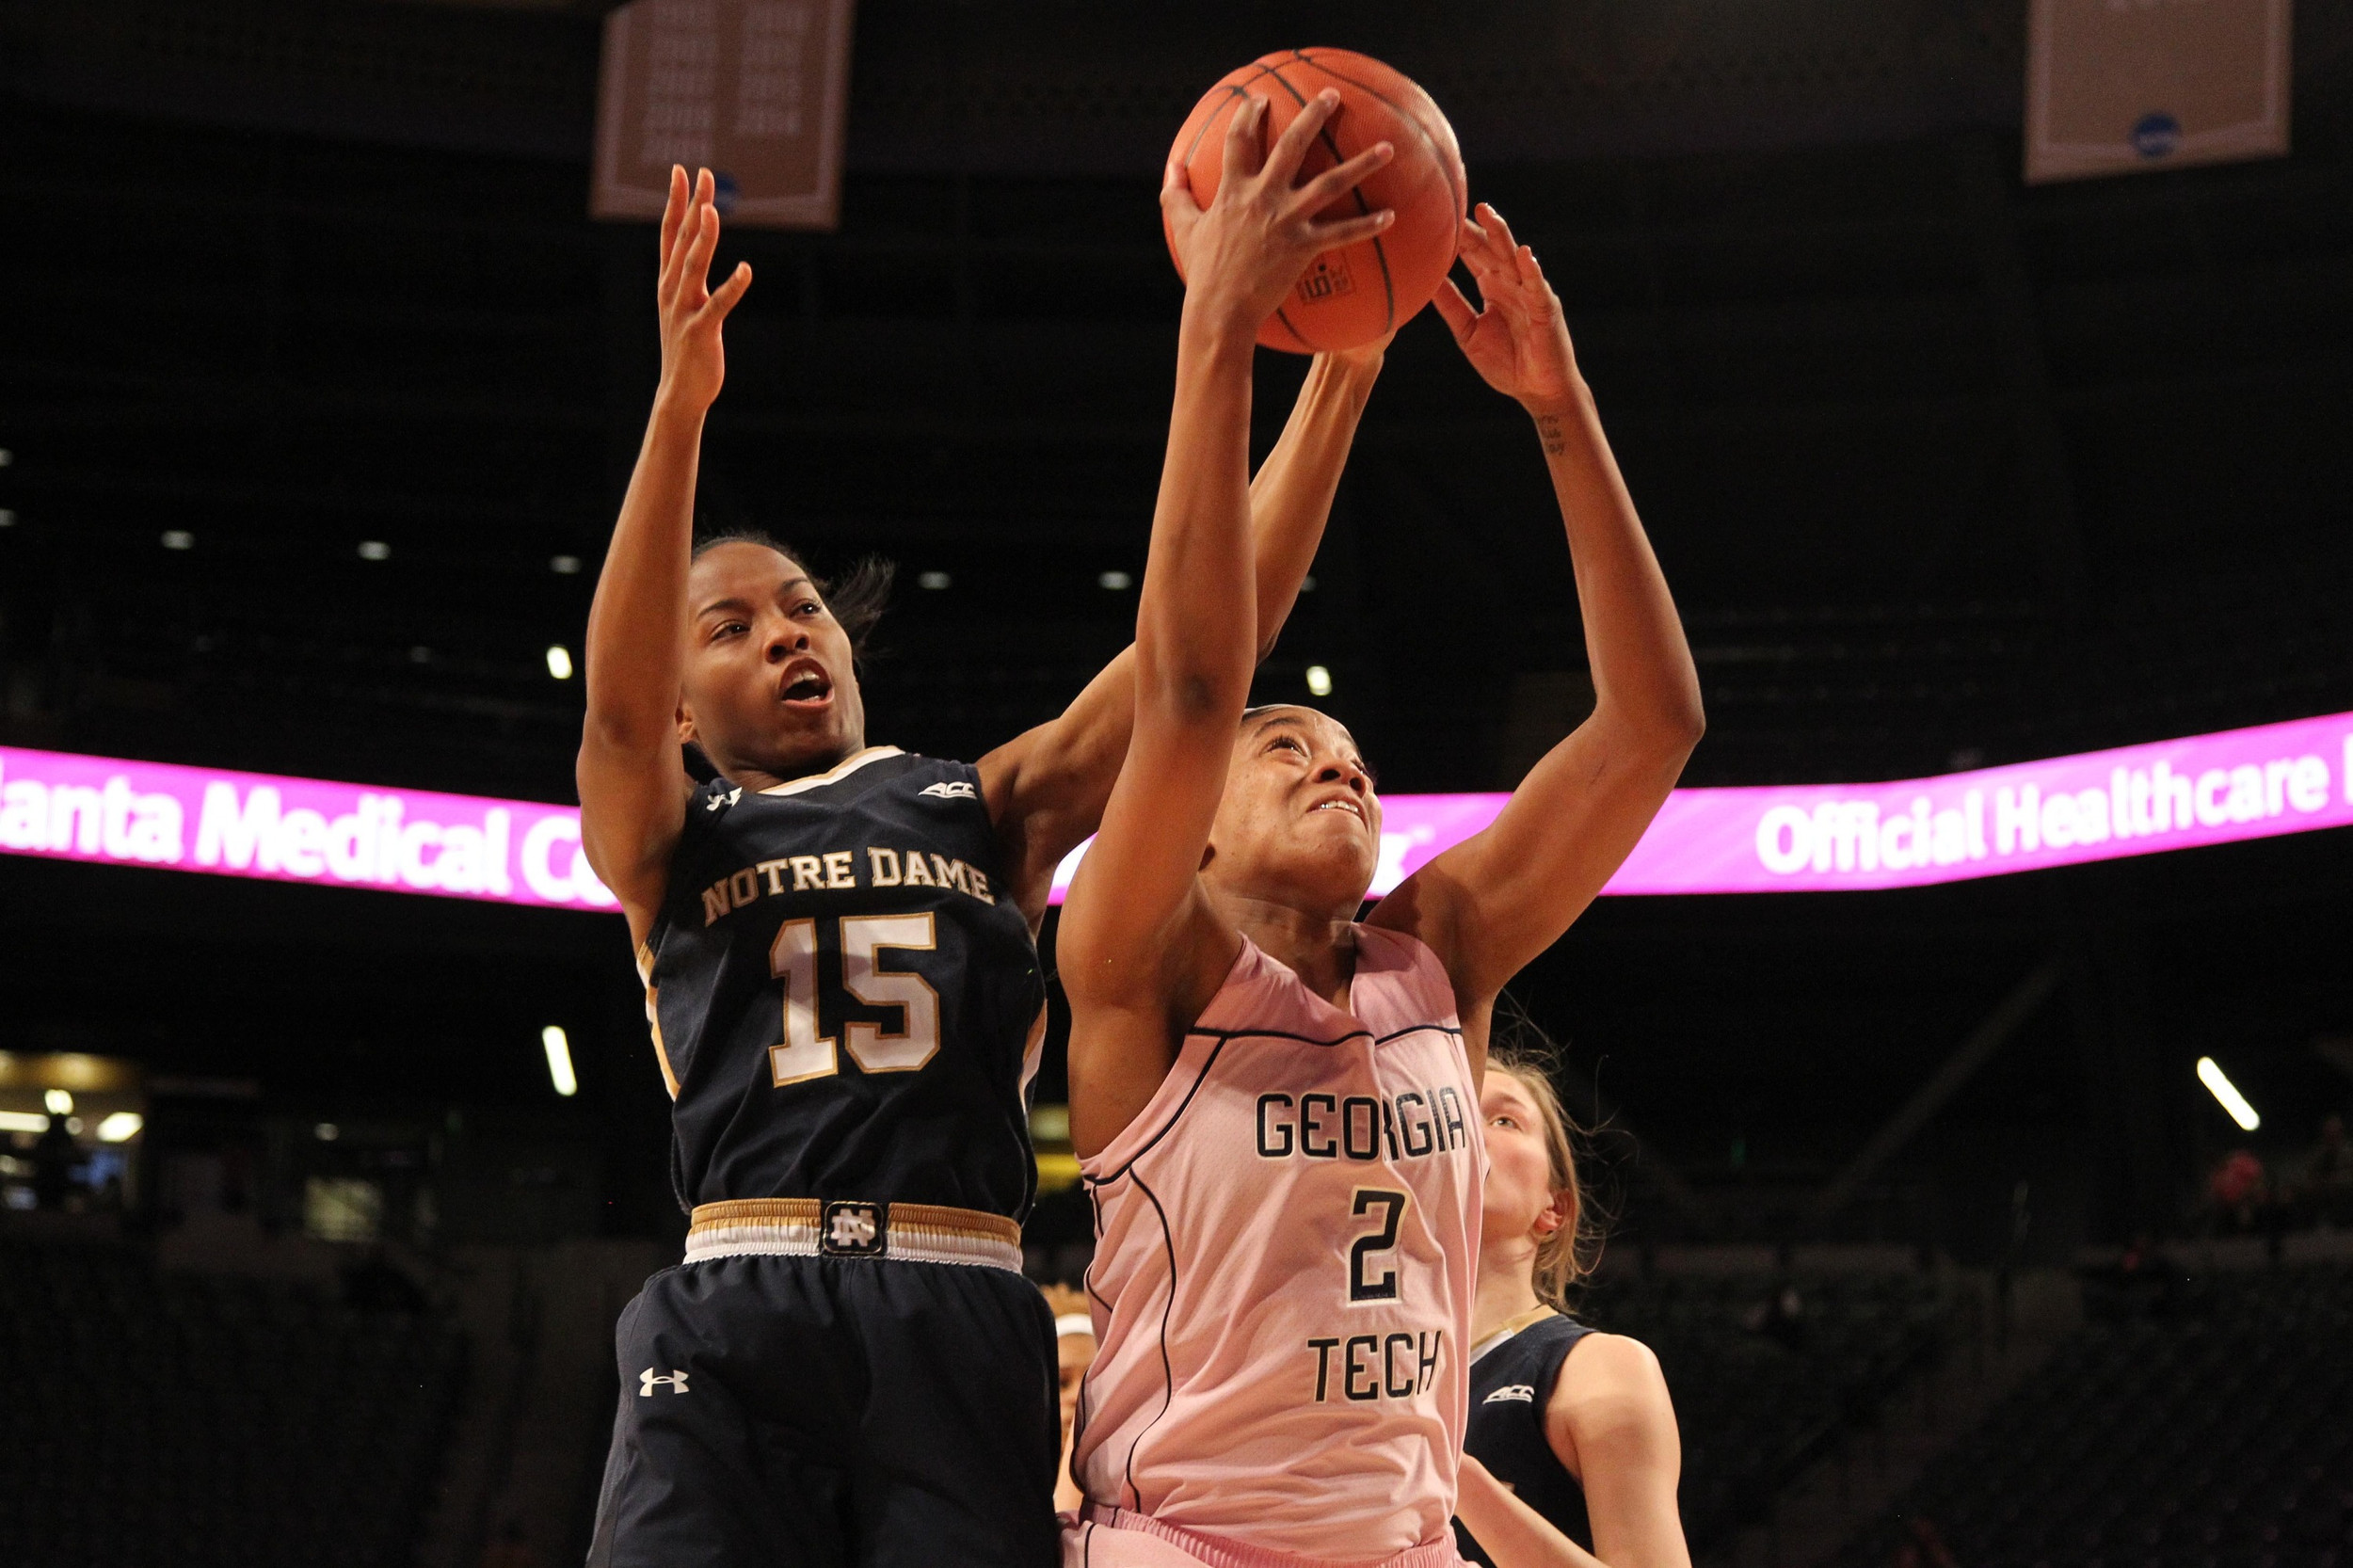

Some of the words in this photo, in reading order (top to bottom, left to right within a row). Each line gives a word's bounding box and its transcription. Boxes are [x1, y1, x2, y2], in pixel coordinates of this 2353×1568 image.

[0, 757, 184, 864] anta
[195, 781, 513, 896] Medical
[1755, 790, 1988, 874] Official
[1995, 755, 2329, 856] Healthcare
[700, 851, 856, 928] NOTRE
[867, 846, 996, 906] DAME
[768, 911, 941, 1089] 15
[1349, 1188, 1408, 1304] 2
[1307, 1330, 1443, 1402] TECH
